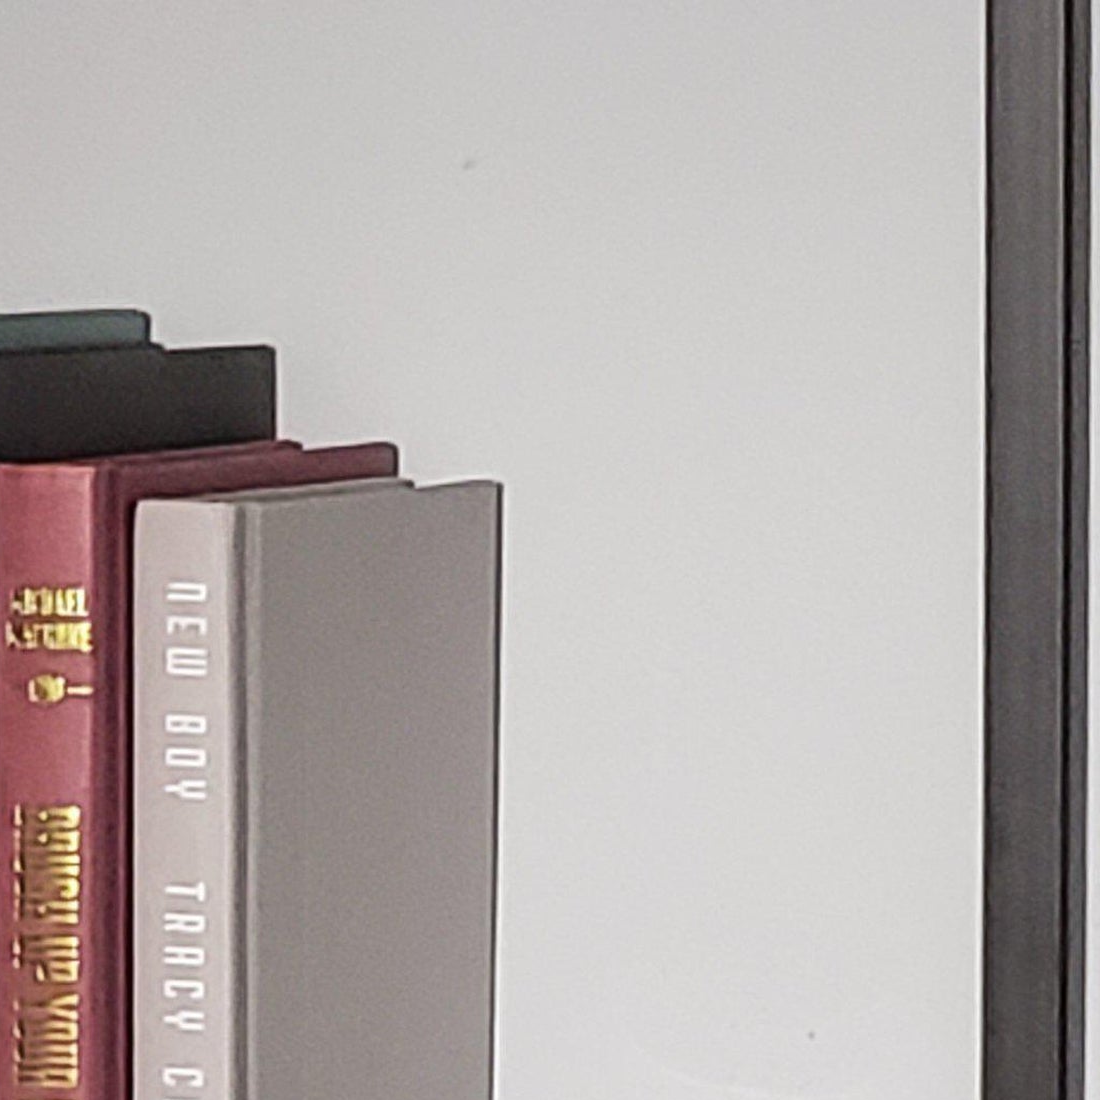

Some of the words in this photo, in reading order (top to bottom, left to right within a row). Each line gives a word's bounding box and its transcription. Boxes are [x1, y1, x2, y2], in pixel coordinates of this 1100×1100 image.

[164, 580, 209, 678] NEW
[162, 712, 208, 800] BOY
[162, 880, 207, 1033] TRACY
[12, 991, 81, 1088] YOUR
